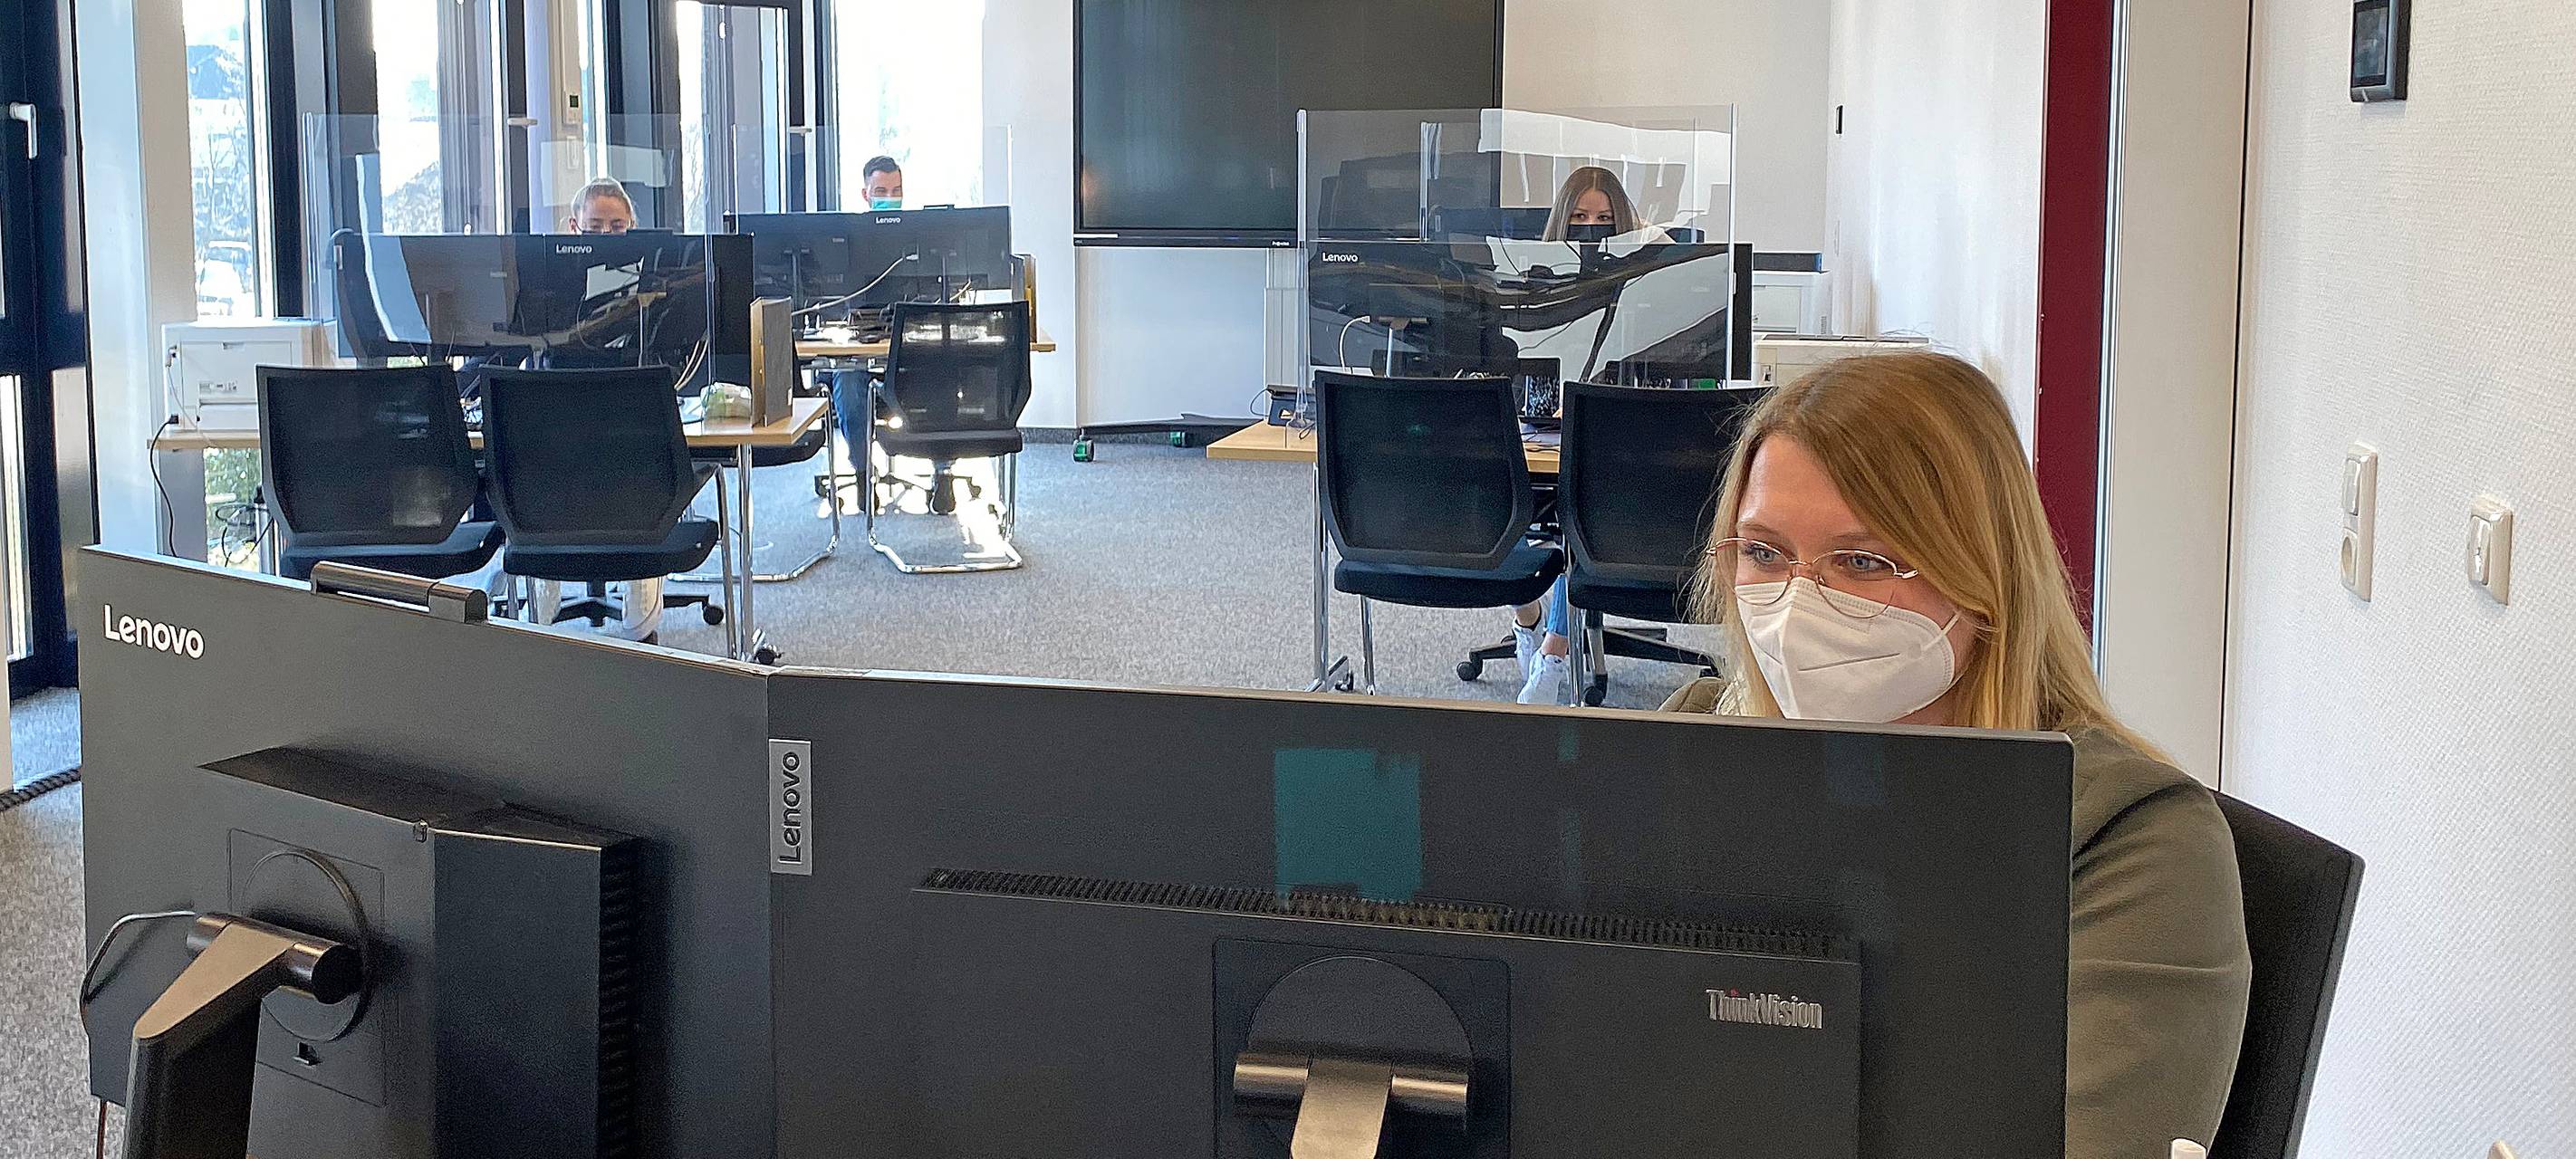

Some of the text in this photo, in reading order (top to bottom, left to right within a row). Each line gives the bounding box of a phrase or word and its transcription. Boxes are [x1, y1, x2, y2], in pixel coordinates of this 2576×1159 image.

[556, 244, 592, 254] Lenovo
[1322, 252, 1359, 263] Lenovo
[104, 603, 205, 659] Lenovo
[778, 752, 802, 863] Lenovo
[1706, 988, 1822, 1029] ThinkVision
